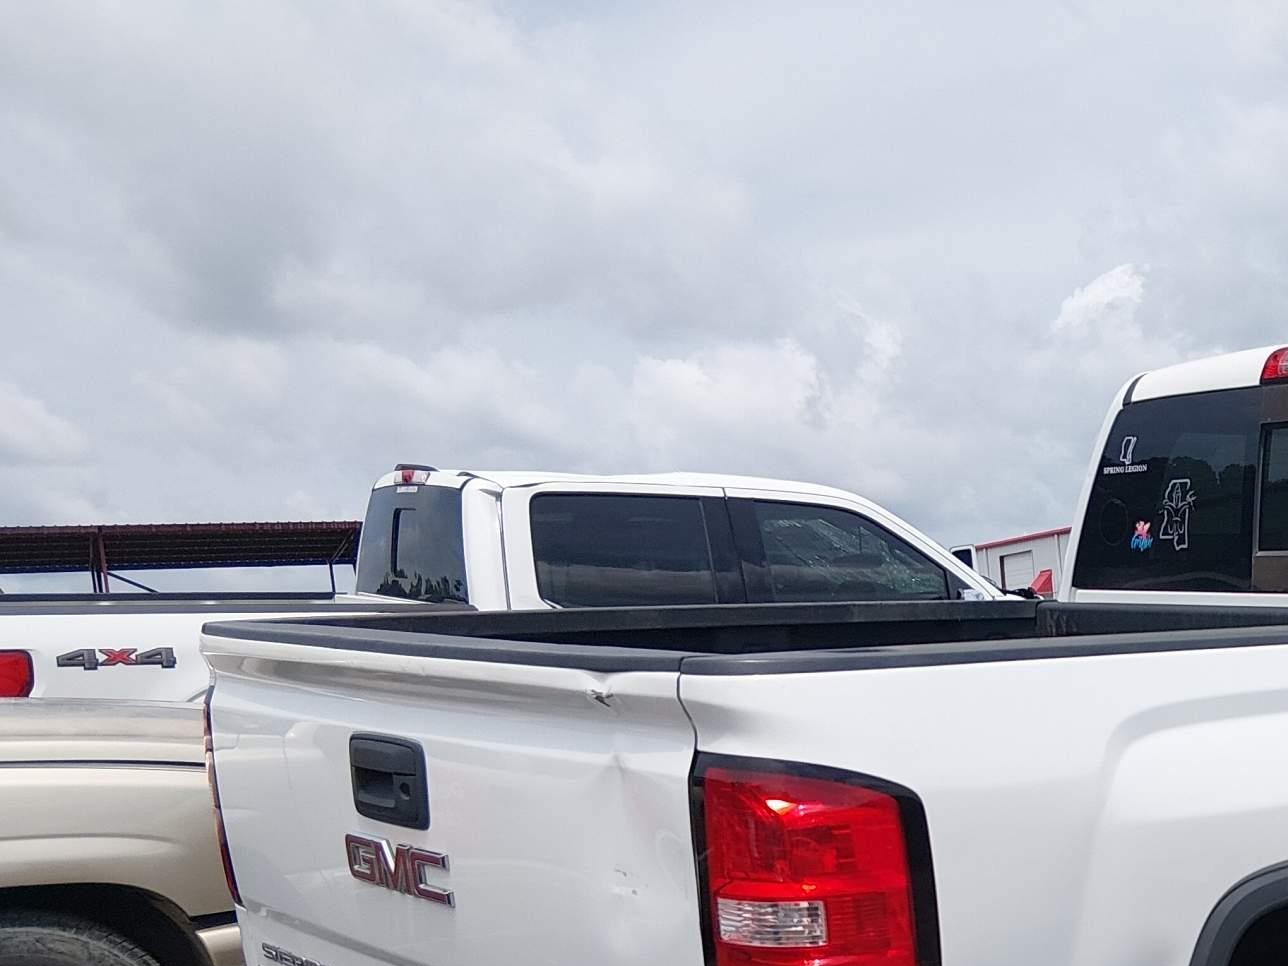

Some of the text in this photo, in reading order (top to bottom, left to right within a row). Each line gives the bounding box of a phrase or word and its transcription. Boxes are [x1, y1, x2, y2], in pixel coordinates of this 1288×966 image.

[1103, 463, 1148, 475] SPRING LEGION
[345, 832, 456, 908] GMC
